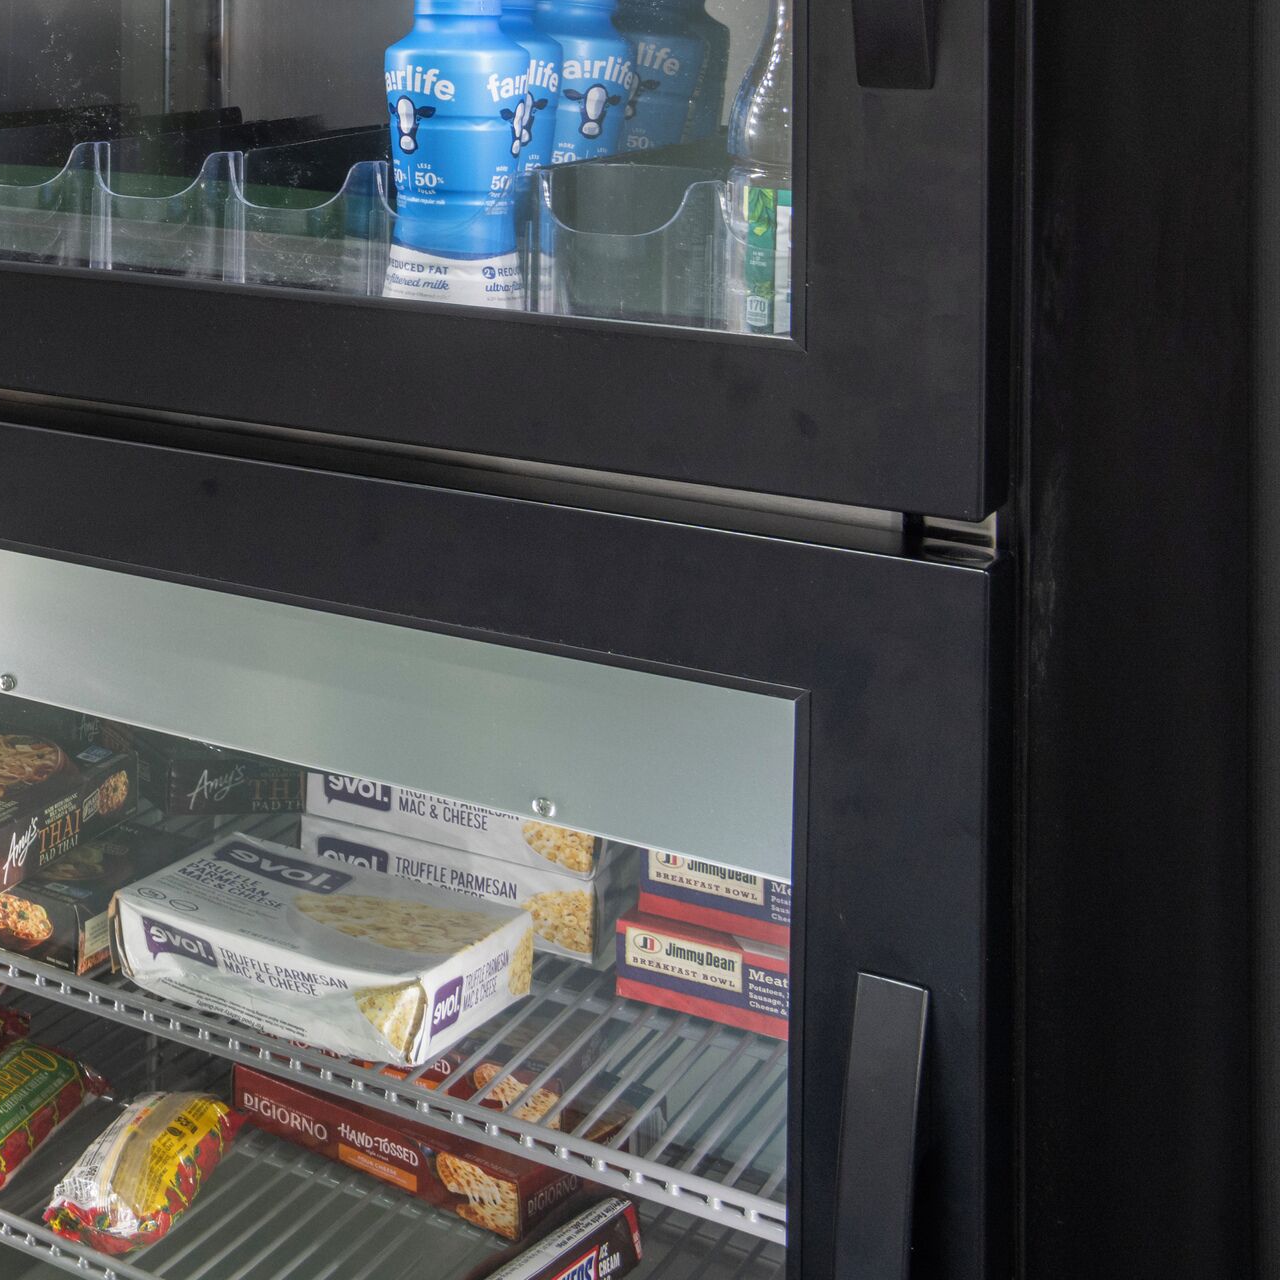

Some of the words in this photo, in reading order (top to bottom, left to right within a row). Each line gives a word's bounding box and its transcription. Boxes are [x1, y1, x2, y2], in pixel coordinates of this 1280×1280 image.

[428, 265, 449, 275] FAT
[40, 808, 81, 854] THAI
[398, 797, 427, 817] MAC
[429, 804, 438, 820] &
[442, 804, 489, 831] CHEESE
[2, 816, 39, 885] Amy's
[57, 834, 79, 857] THAI
[188, 862, 270, 898] PARMESAN
[196, 857, 260, 888] TRUFFLE
[395, 856, 447, 884] TRUFFLE
[450, 870, 518, 901] PARMESAN
[655, 871, 721, 892] BREAKFAST
[725, 887, 758, 901] BOWL
[219, 946, 272, 975] TRUFFLE
[275, 963, 349, 991] PARMESAN
[632, 956, 697, 978] BREAKFAST
[702, 973, 736, 988] BOWL
[665, 941, 705, 966] Jimmy
[705, 952, 736, 972] Dean
[223, 959, 253, 980] MAC
[268, 973, 319, 998] CHEESE
[748, 968, 789, 988] Meat
[749, 1000, 780, 1014] Cheese
[242, 1092, 328, 1141] DIGIORNO
[337, 1122, 419, 1168] HAND-TOSSED
